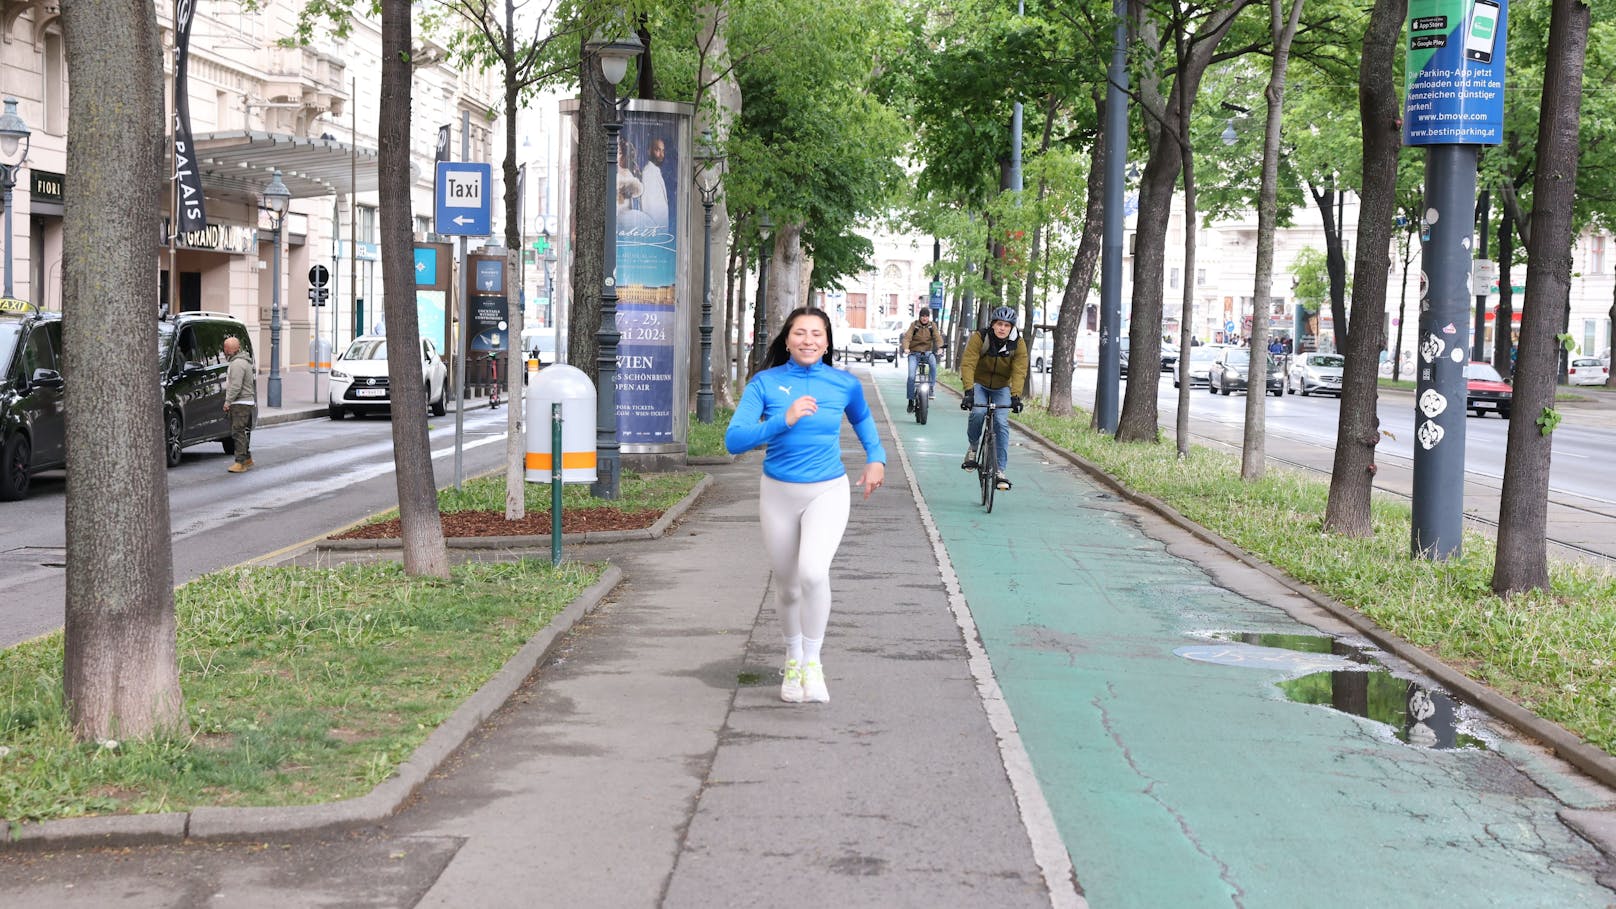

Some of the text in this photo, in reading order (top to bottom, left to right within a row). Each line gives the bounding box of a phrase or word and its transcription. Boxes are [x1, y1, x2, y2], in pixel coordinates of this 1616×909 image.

[1417, 40, 1432, 48] Google
[1433, 38, 1445, 47] Play
[1408, 68, 1492, 79] Die Parking-App jetzt
[1408, 80, 1452, 90] downloaden
[1454, 79, 1471, 87] und
[1488, 80, 1501, 88] den
[1407, 90, 1496, 101] Kennzeichen günstiger
[1407, 102, 1432, 112] parken!
[1418, 112, 1487, 121] www.bmove.com
[1410, 127, 1495, 137] www.bestinparking.at
[175, 140, 201, 220] PALAIS
[37, 180, 61, 196] FIORI
[448, 178, 478, 198] Taxi
[187, 225, 218, 248] GRAND
[642, 312, 660, 325] 29.
[620, 327, 665, 340] ai 2024
[616, 355, 653, 369] WIEN
[624, 372, 672, 381] SCHÖNBRUNN
[636, 383, 650, 391] AIR
